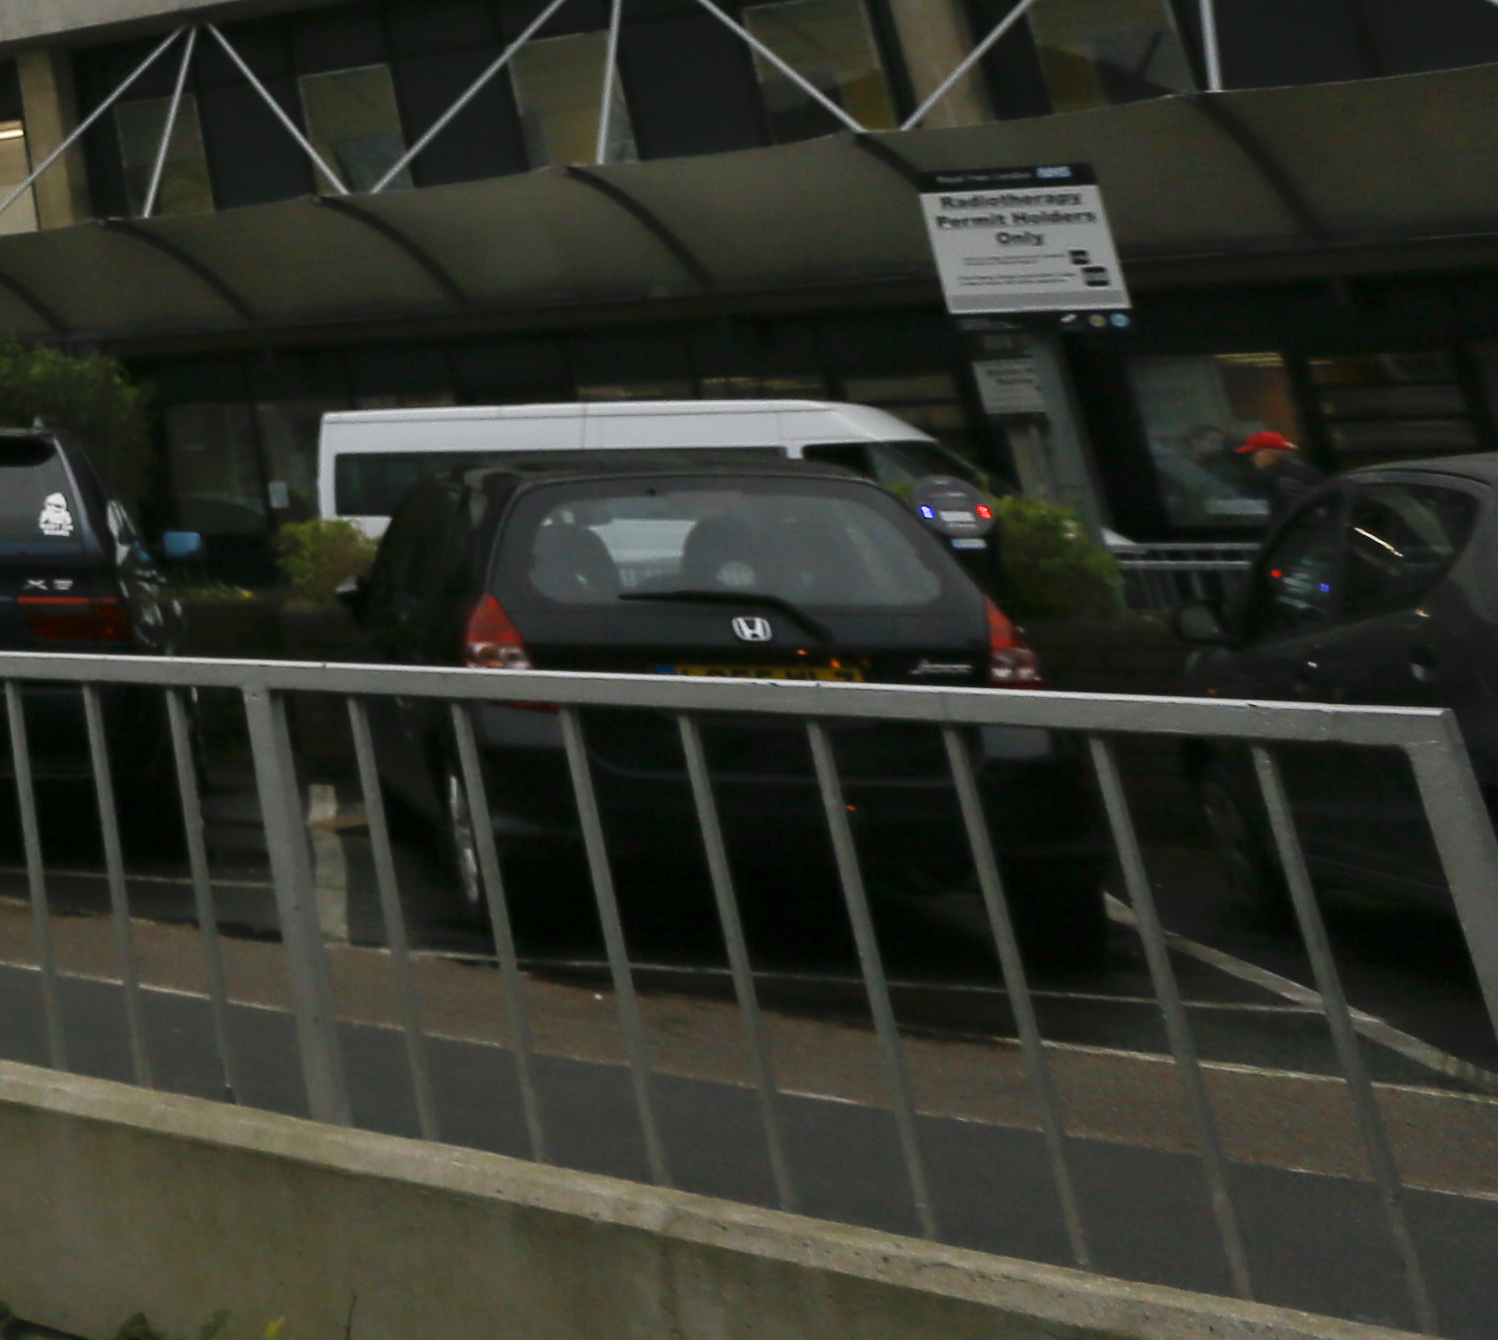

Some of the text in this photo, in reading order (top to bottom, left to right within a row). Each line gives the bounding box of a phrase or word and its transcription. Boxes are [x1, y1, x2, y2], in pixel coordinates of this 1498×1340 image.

[939, 192, 1082, 209] Radiotherapy
[936, 210, 1097, 230] Permit Holders
[994, 231, 1045, 247] Only
